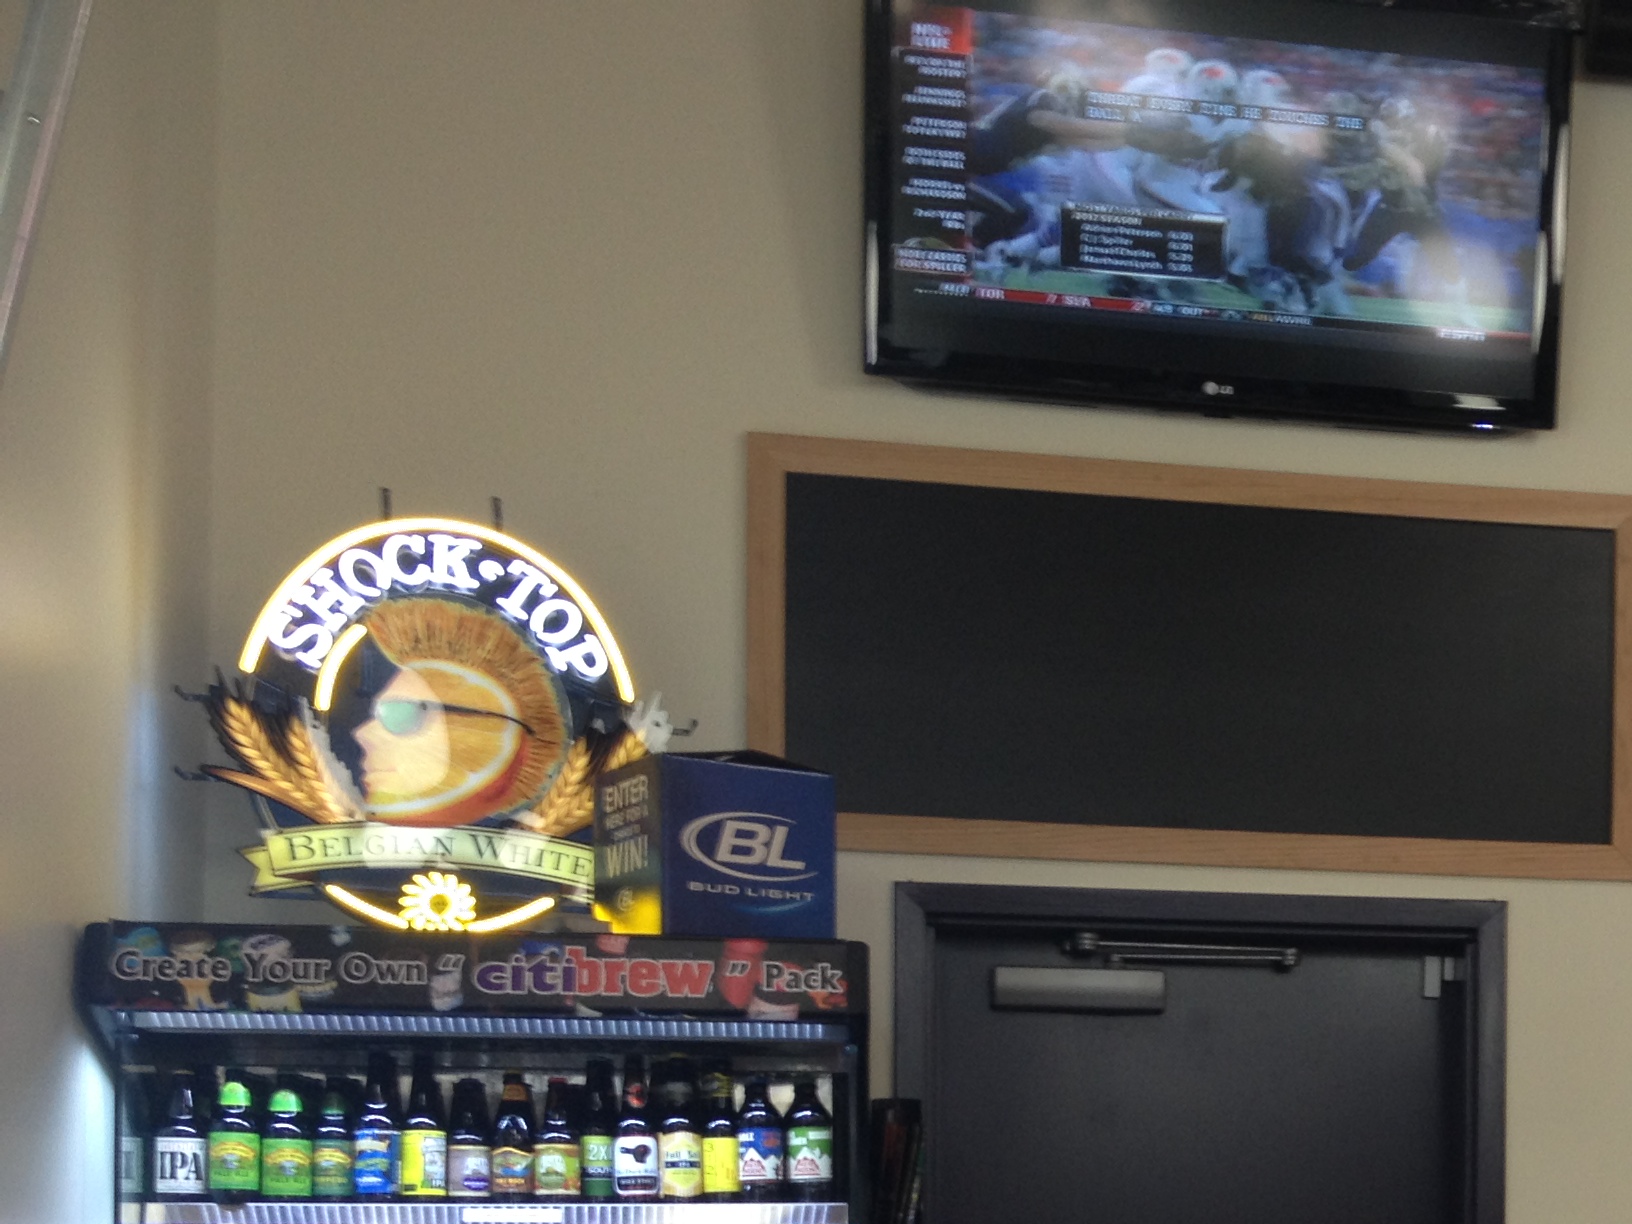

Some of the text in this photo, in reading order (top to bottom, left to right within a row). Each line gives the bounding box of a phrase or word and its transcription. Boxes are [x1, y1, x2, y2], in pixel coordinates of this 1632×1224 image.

[604, 773, 649, 814] ENTER
[284, 833, 594, 878] BELGIAN WHITE
[606, 835, 649, 879] WIN!
[714, 819, 806, 871] BL
[686, 880, 815, 902] BUD LIGHT
[111, 947, 233, 982] Create
[243, 948, 332, 984] Your
[340, 951, 428, 986] Own
[761, 960, 844, 995] Pack
[158, 1150, 205, 1181] IPA
[588, 1144, 608, 1160] 2X
